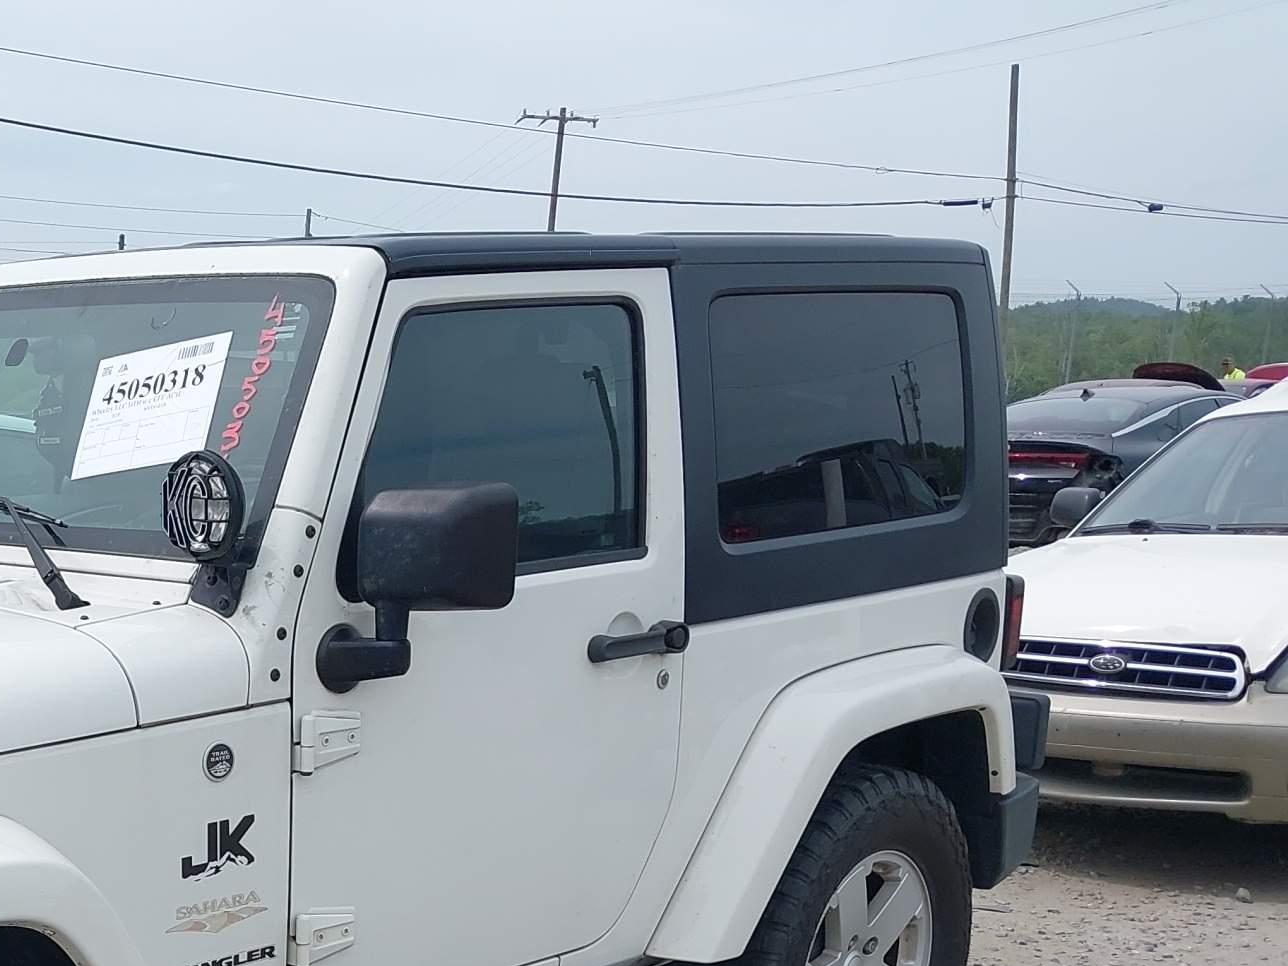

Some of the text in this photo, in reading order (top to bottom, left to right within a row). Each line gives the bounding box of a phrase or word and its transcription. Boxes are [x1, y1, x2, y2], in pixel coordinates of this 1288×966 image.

[102, 363, 207, 405] 45050318
[220, 292, 285, 457] 450503
[161, 467, 208, 548] KC
[181, 814, 255, 880] JK
[175, 890, 261, 921] SAHARA
